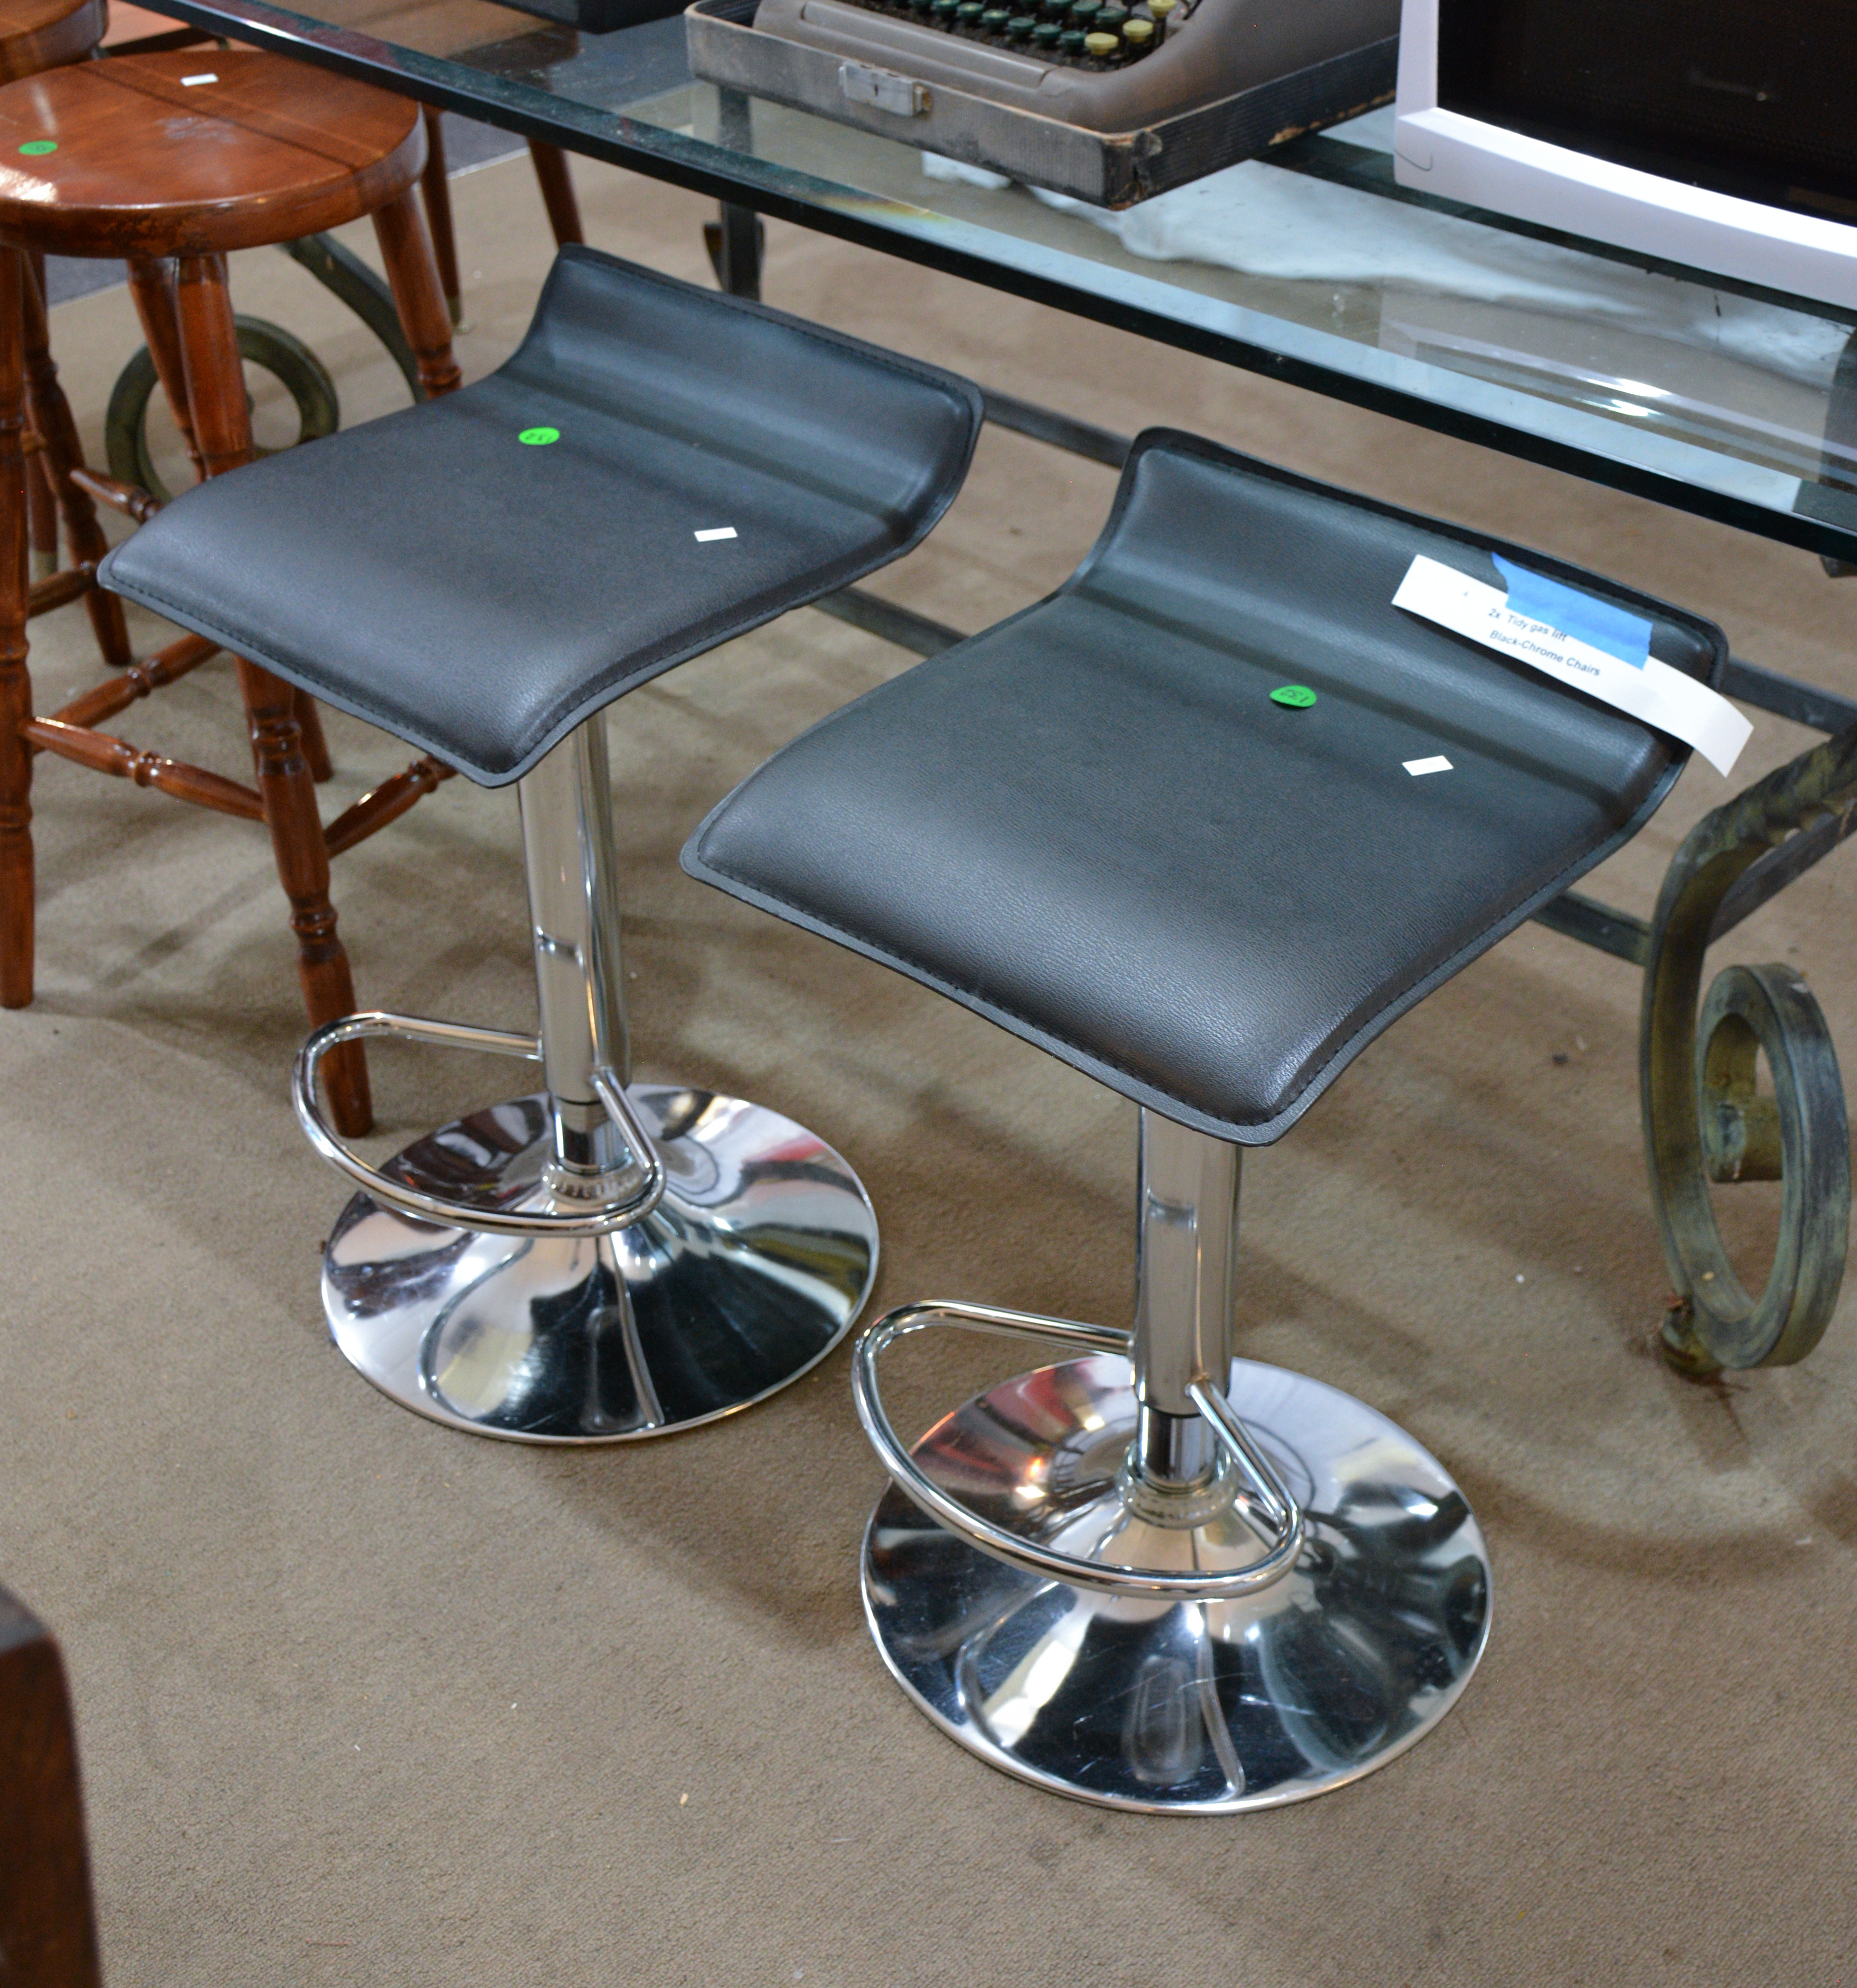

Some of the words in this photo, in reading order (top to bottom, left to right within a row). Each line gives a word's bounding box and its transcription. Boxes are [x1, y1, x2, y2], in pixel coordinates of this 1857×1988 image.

[1488, 608, 1501, 619] 2x
[1507, 615, 1529, 630] Tidy
[1529, 623, 1549, 634] gas
[1552, 628, 1567, 641] lift
[1489, 630, 1564, 663] Black-Chrome
[1566, 657, 1600, 676] Chairs
